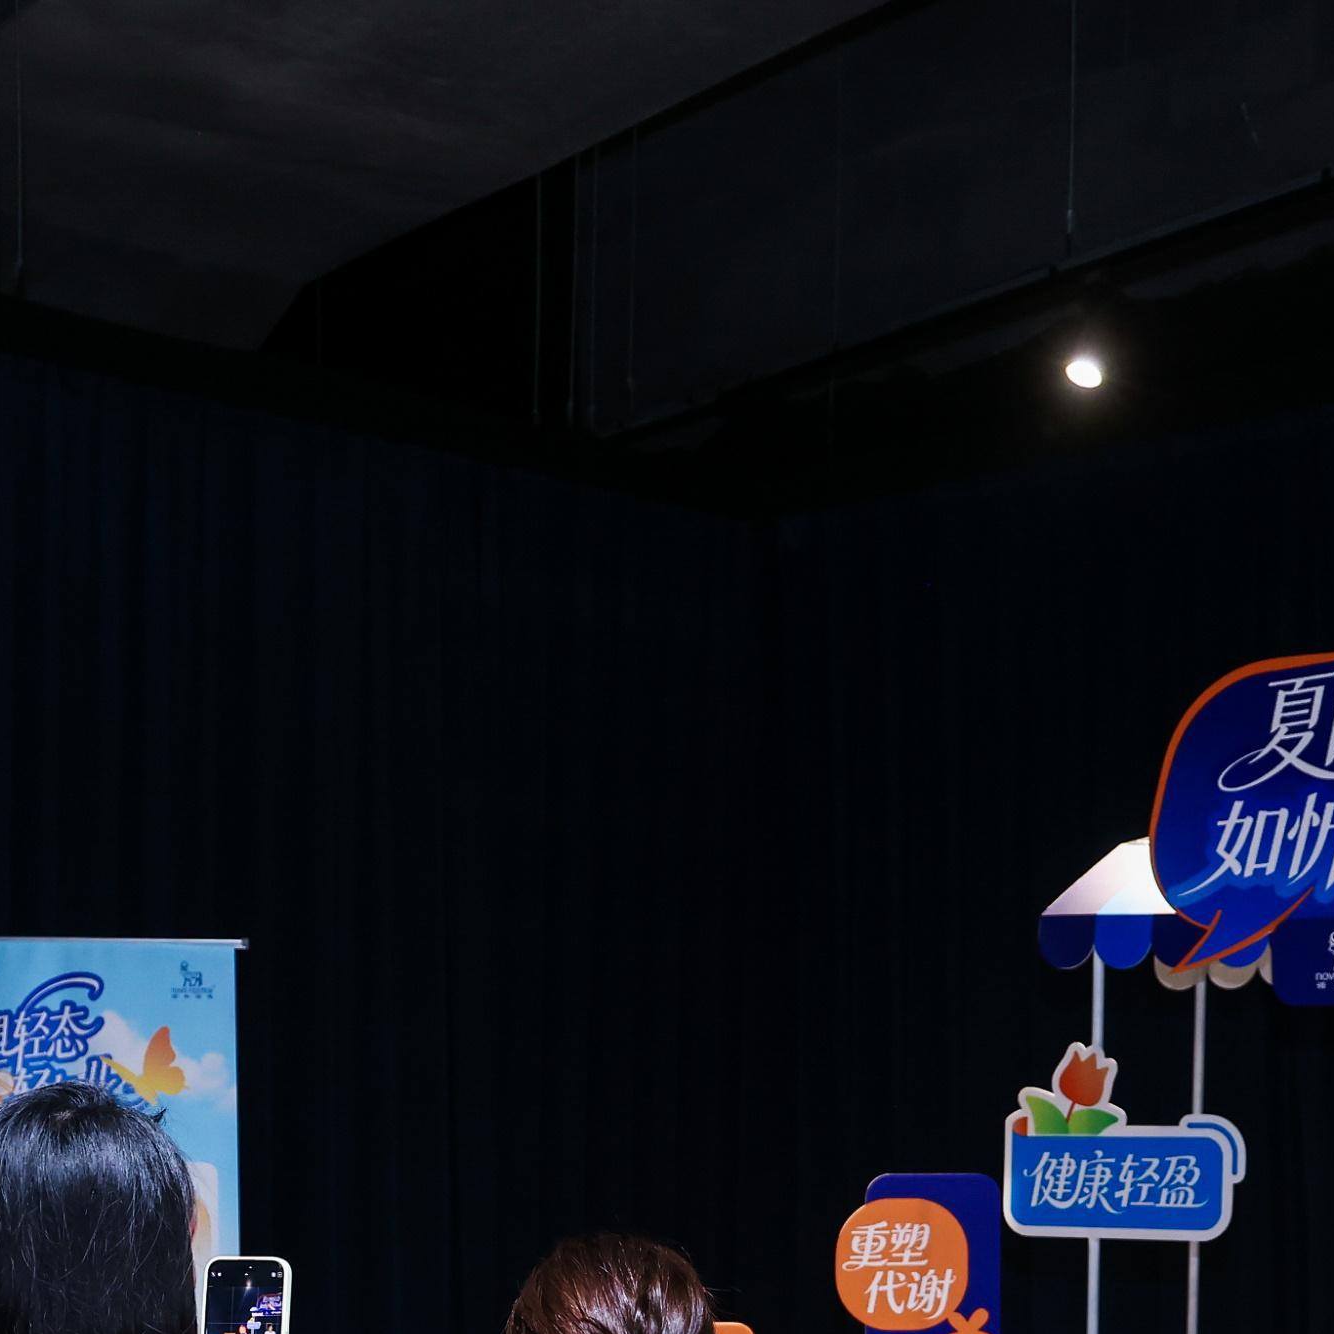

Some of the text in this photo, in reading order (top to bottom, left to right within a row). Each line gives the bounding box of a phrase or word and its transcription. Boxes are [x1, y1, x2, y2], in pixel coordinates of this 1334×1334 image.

[1023, 1149, 1209, 1214] 健康轻盈
[842, 1220, 932, 1272] 重塑
[864, 1269, 956, 1320] 代谢
